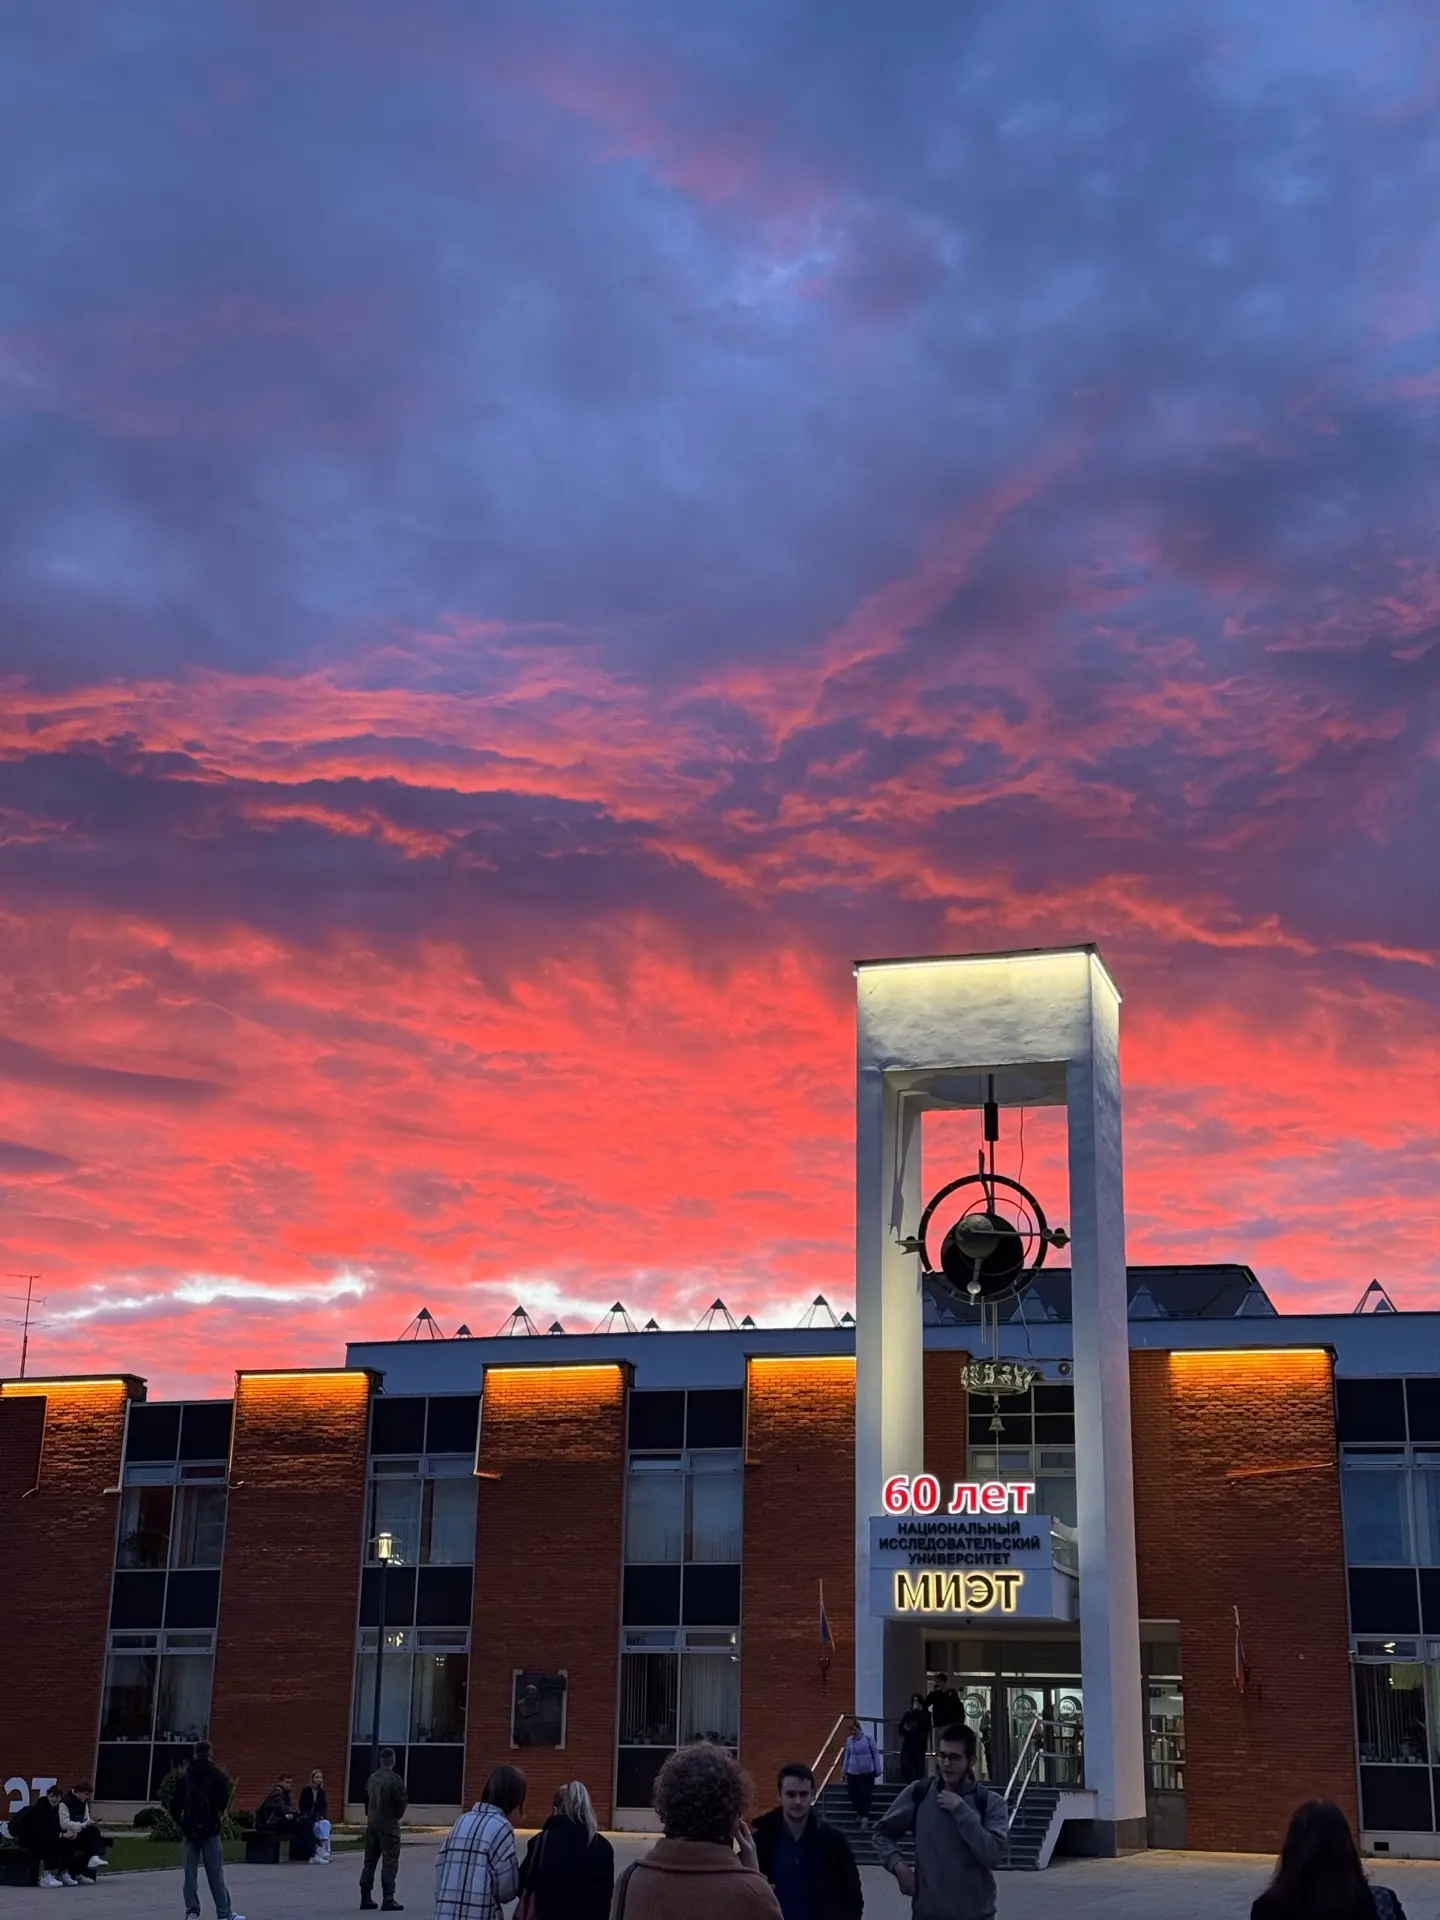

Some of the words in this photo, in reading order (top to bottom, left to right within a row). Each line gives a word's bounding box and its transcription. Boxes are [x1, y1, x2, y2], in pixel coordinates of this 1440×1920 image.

[883, 1474, 941, 1515] 60
[949, 1482, 1035, 1514] лет
[898, 1521, 1021, 1537] НАЦИОНАЛЬНЫЙ
[879, 1536, 1041, 1551] ИССЛЕДОВАТЕЛЬСКИЙ
[908, 1552, 1011, 1566] УНИВЕРСИТЕТ
[895, 1573, 1022, 1611] МИЭТ
